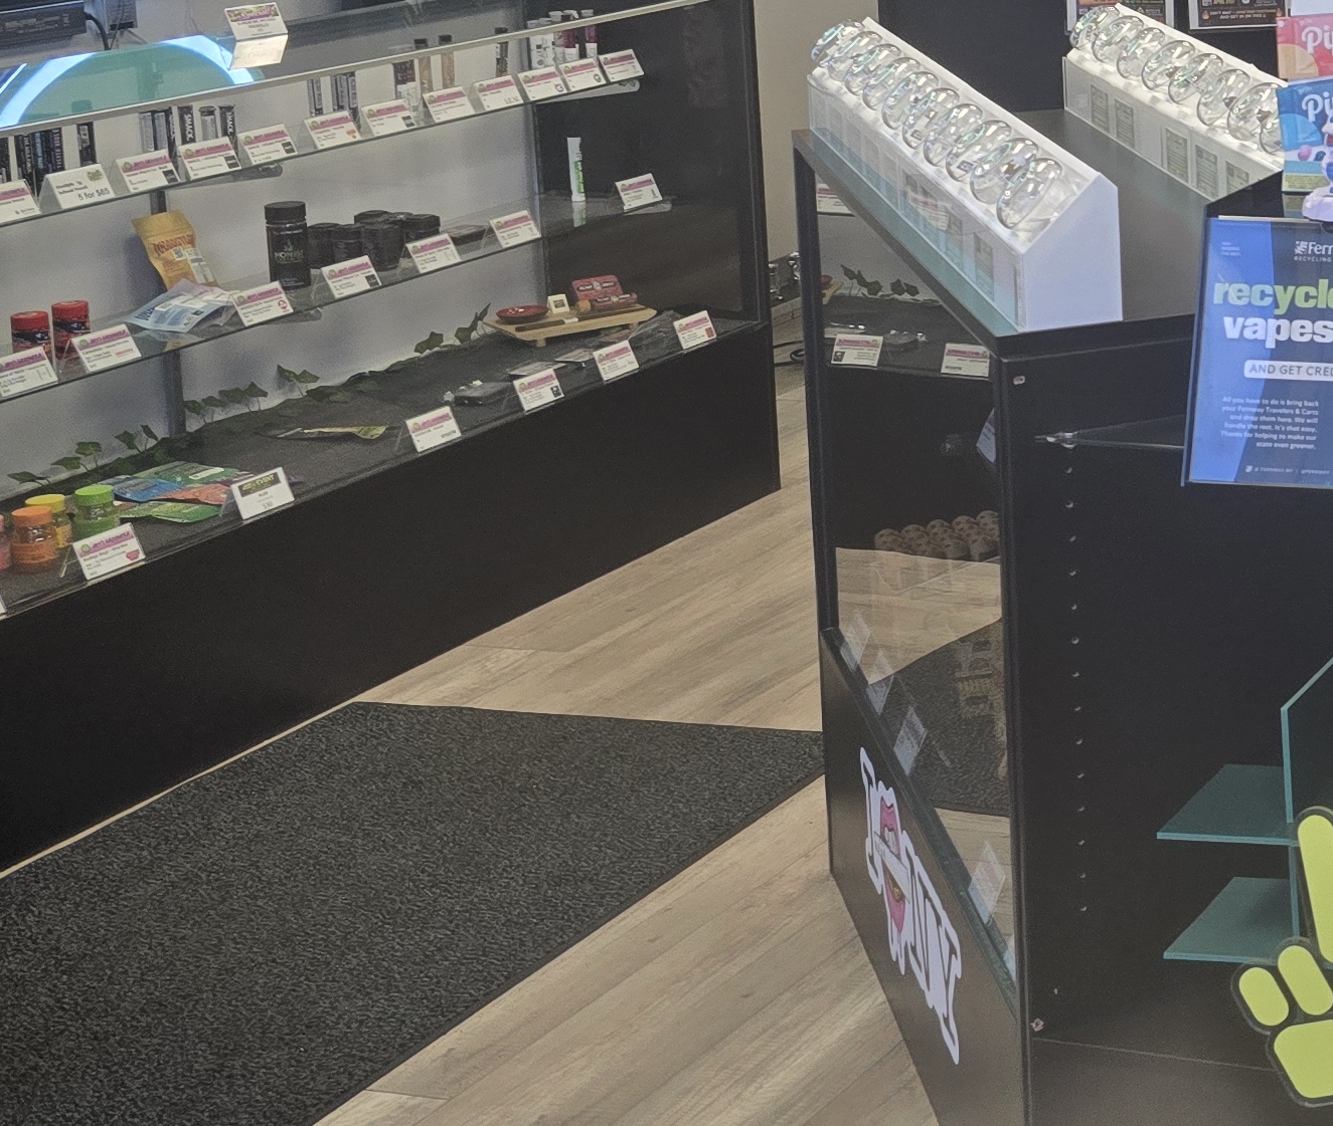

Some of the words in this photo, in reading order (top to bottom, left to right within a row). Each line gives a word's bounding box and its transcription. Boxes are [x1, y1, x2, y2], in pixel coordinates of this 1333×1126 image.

[85, 191, 96, 200] for
[97, 188, 110, 198] $65
[1250, 364, 1275, 374] AND
[1279, 365, 1302, 375] GET
